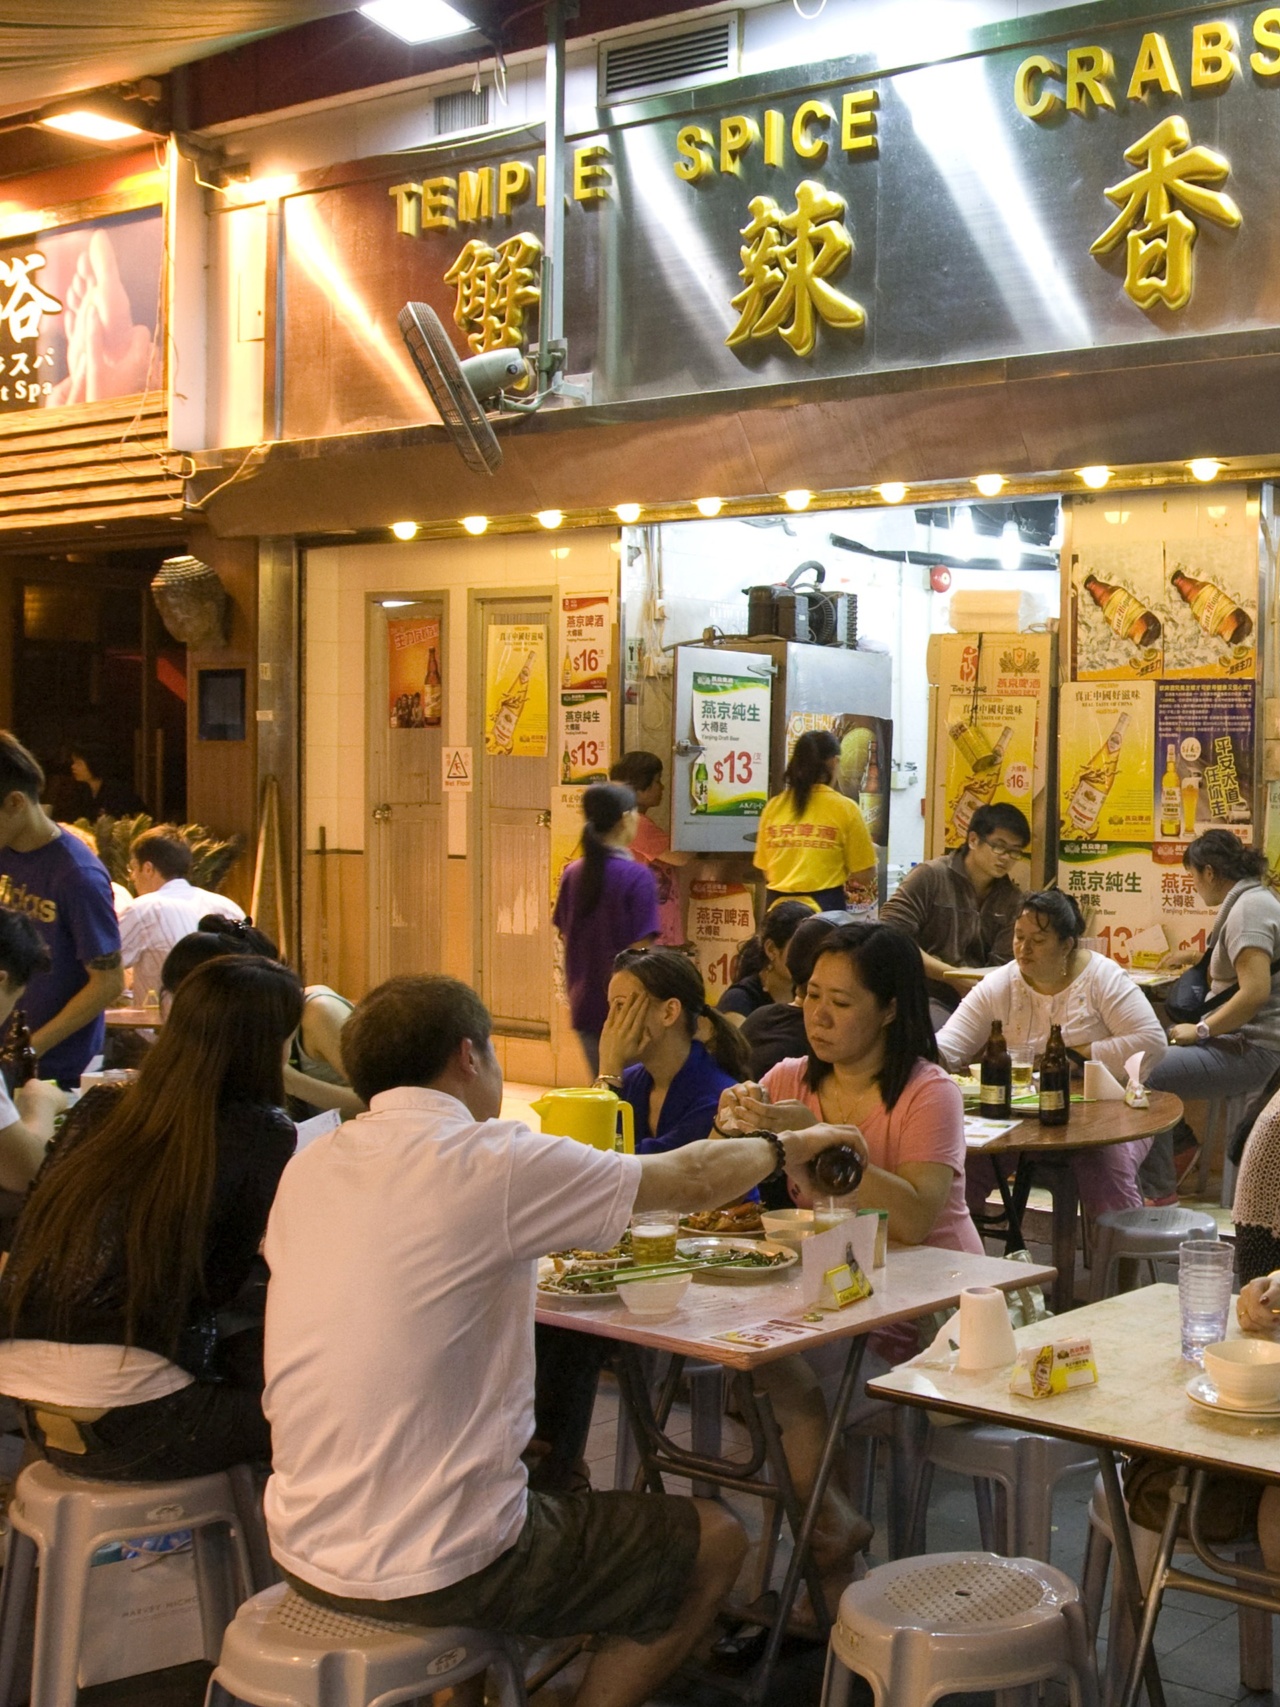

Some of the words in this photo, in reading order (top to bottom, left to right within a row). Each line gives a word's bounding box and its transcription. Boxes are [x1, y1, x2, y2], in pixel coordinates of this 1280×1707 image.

[389, 145, 609, 237] TEMPLE
[674, 89, 879, 182] SPICE
[1090, 115, 1241, 311] 香
[725, 180, 866, 356] 辣
[444, 231, 544, 391] 蟹
[0, 347, 55, 377] スパ
[15, 380, 53, 402] Spa
[567, 615, 604, 628] 燕京啤酒
[573, 649, 599, 671] $16
[1075, 690, 1141, 701] 真正中國好滋味
[565, 711, 600, 723] 燕京純生
[701, 700, 761, 722] 燕京純生
[701, 721, 728, 734] 大樽裝
[570, 741, 599, 767] $13
[713, 750, 753, 784] $13
[1215, 736, 1241, 804] 平安大道
[1007, 775, 1024, 789] $16
[1204, 766, 1228, 818] 任你走
[1068, 870, 1142, 893] 燕京純生
[1161, 873, 1198, 894] 燕京
[1161, 895, 1195, 908] 大樽裝
[1162, 907, 1182, 915] Yanjing
[696, 907, 750, 927] 燕京啤酒
[1097, 926, 1133, 965] 13
